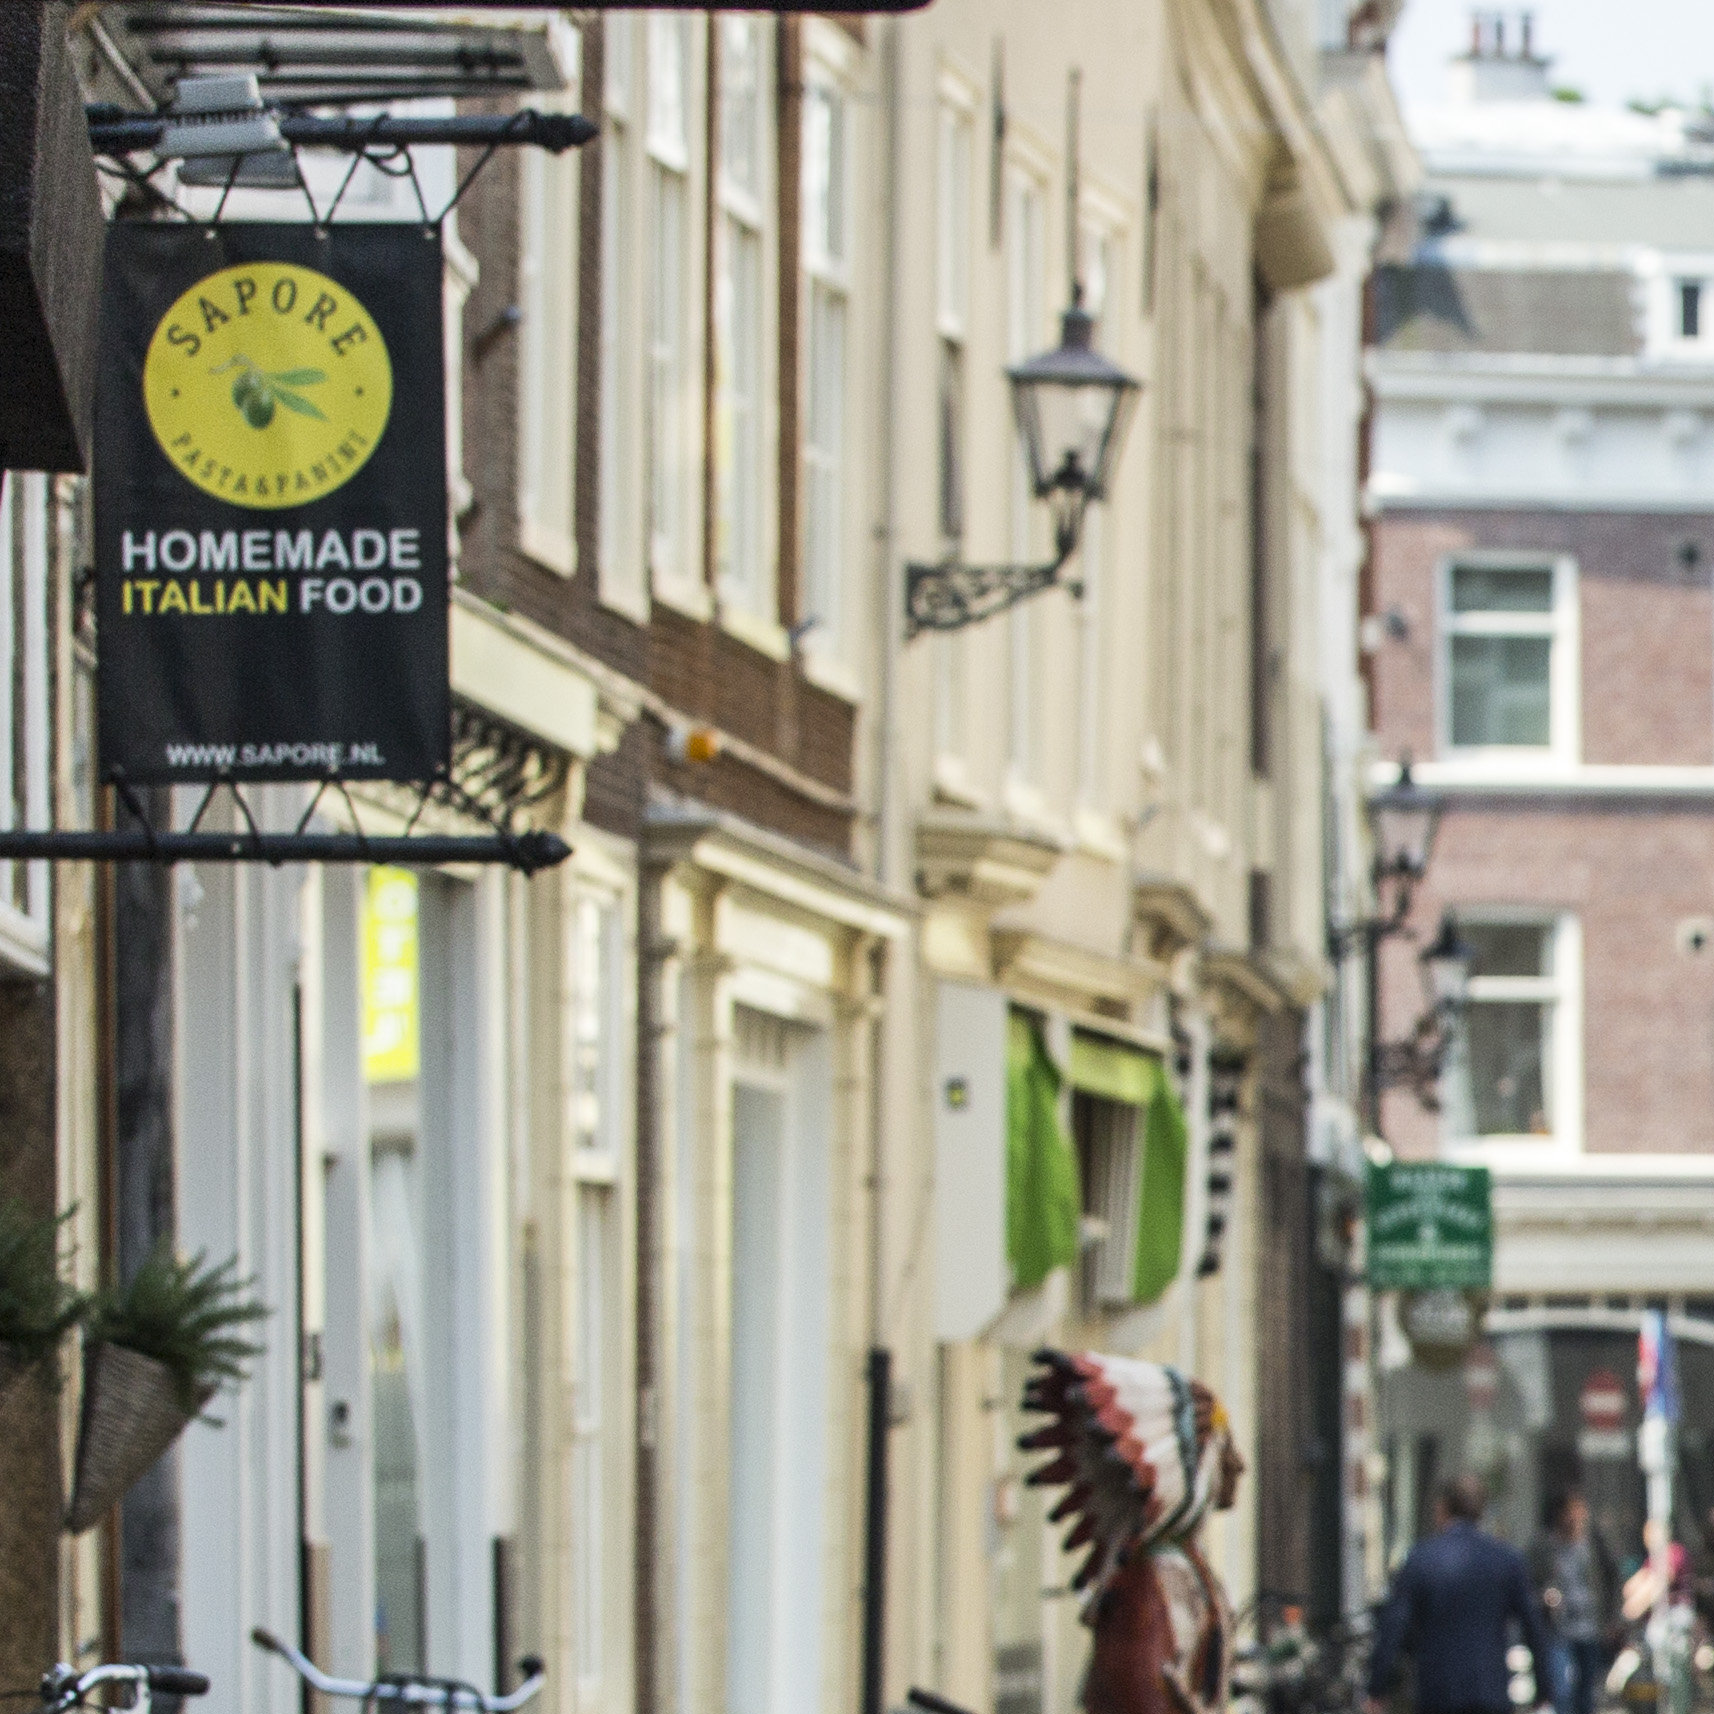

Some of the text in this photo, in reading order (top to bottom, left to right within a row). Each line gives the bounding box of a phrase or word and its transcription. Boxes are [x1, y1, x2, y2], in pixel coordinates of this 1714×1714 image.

[167, 277, 368, 358] SAPORE
[122, 528, 421, 571] HOMEMADE
[122, 576, 423, 615] ITALIAN FOOD
[166, 743, 386, 766] WWW.SAPORE.NL
